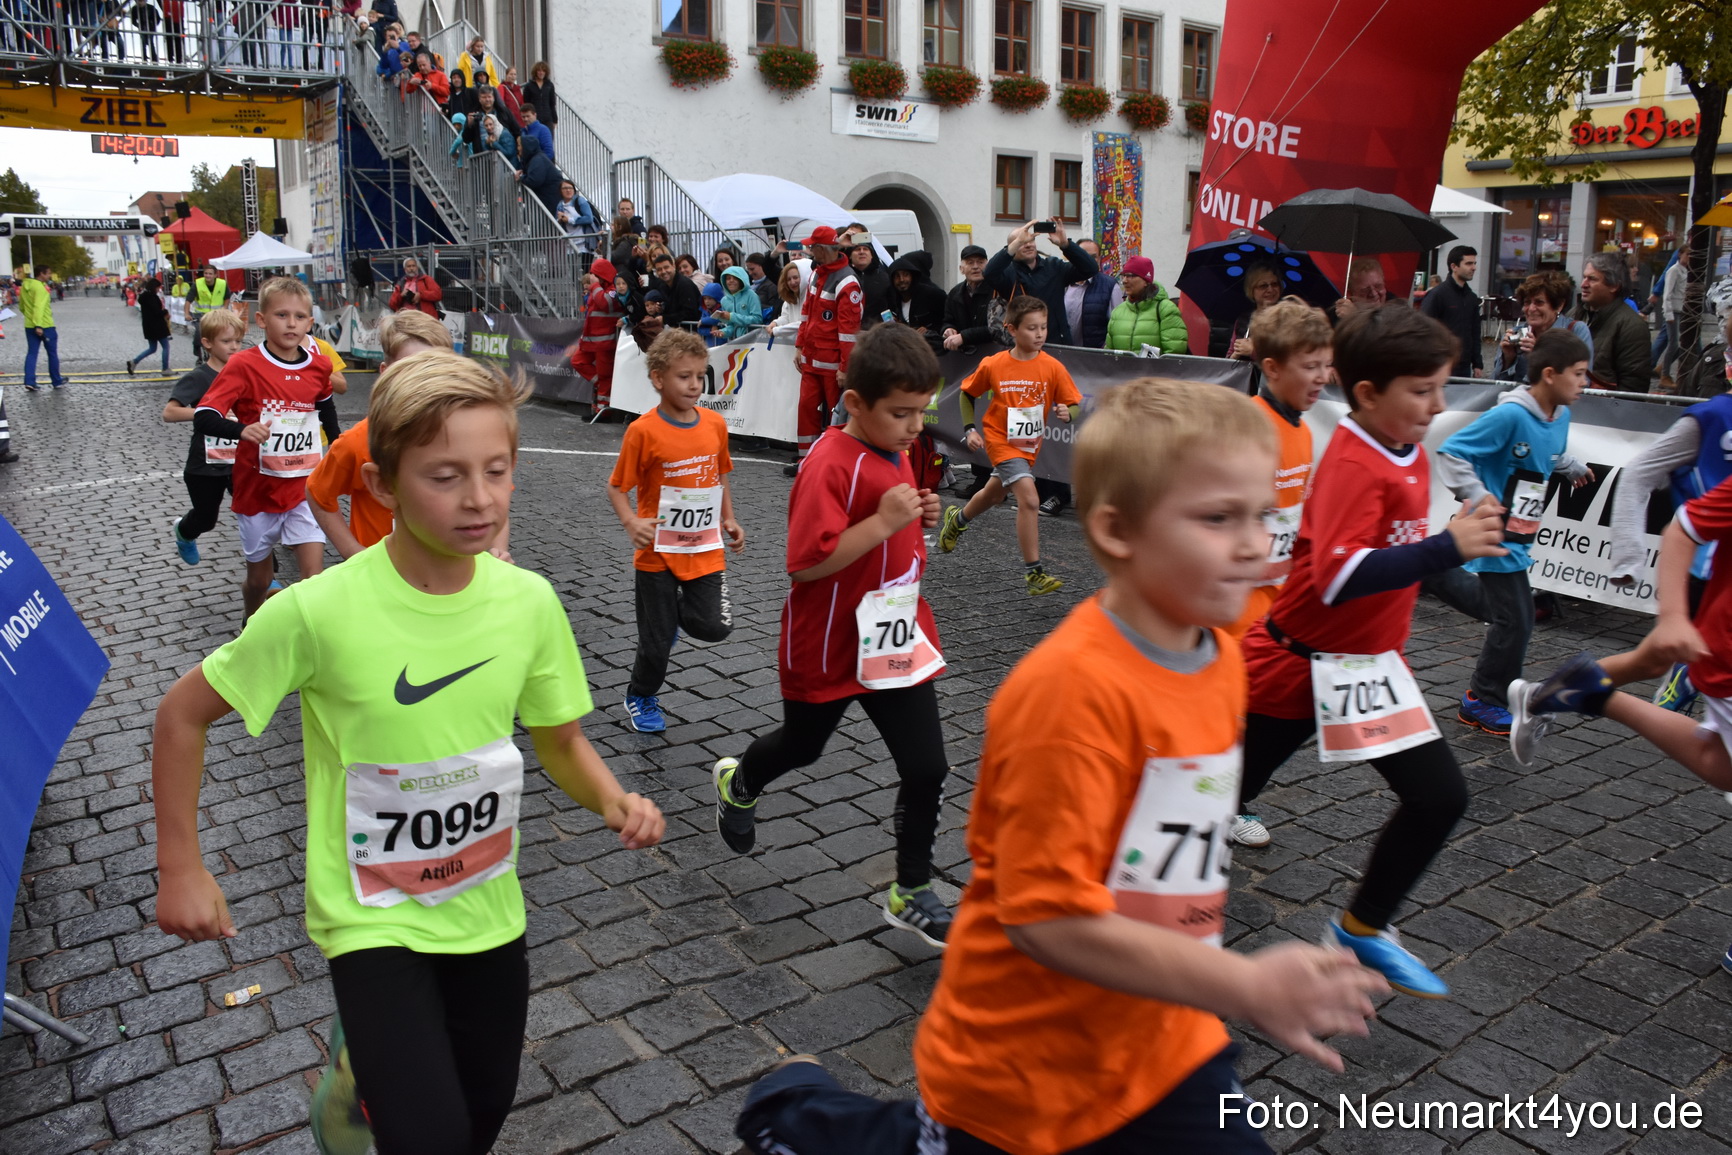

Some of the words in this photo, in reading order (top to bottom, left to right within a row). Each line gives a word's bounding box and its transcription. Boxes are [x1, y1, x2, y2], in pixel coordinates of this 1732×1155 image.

[80, 96, 167, 127] ZIEL
[855, 104, 898, 122] swn
[884, 121, 909, 130] neumarkt
[1211, 109, 1301, 159] STORE
[1570, 121, 1620, 145] Der
[25, 218, 57, 229] MINI
[471, 333, 509, 356] BOCK
[271, 430, 313, 452] 7024
[284, 457, 304, 466] Daniel
[662, 454, 711, 469] Neumarkter
[663, 464, 703, 478] Stadtlauf
[670, 507, 713, 529] 7075
[1541, 558, 1608, 591] bieten
[0, 589, 51, 652] MOBILE
[1333, 675, 1400, 717] 7021
[376, 791, 500, 852] 7099
[355, 850, 369, 859] B6
[420, 858, 465, 883] Attila
